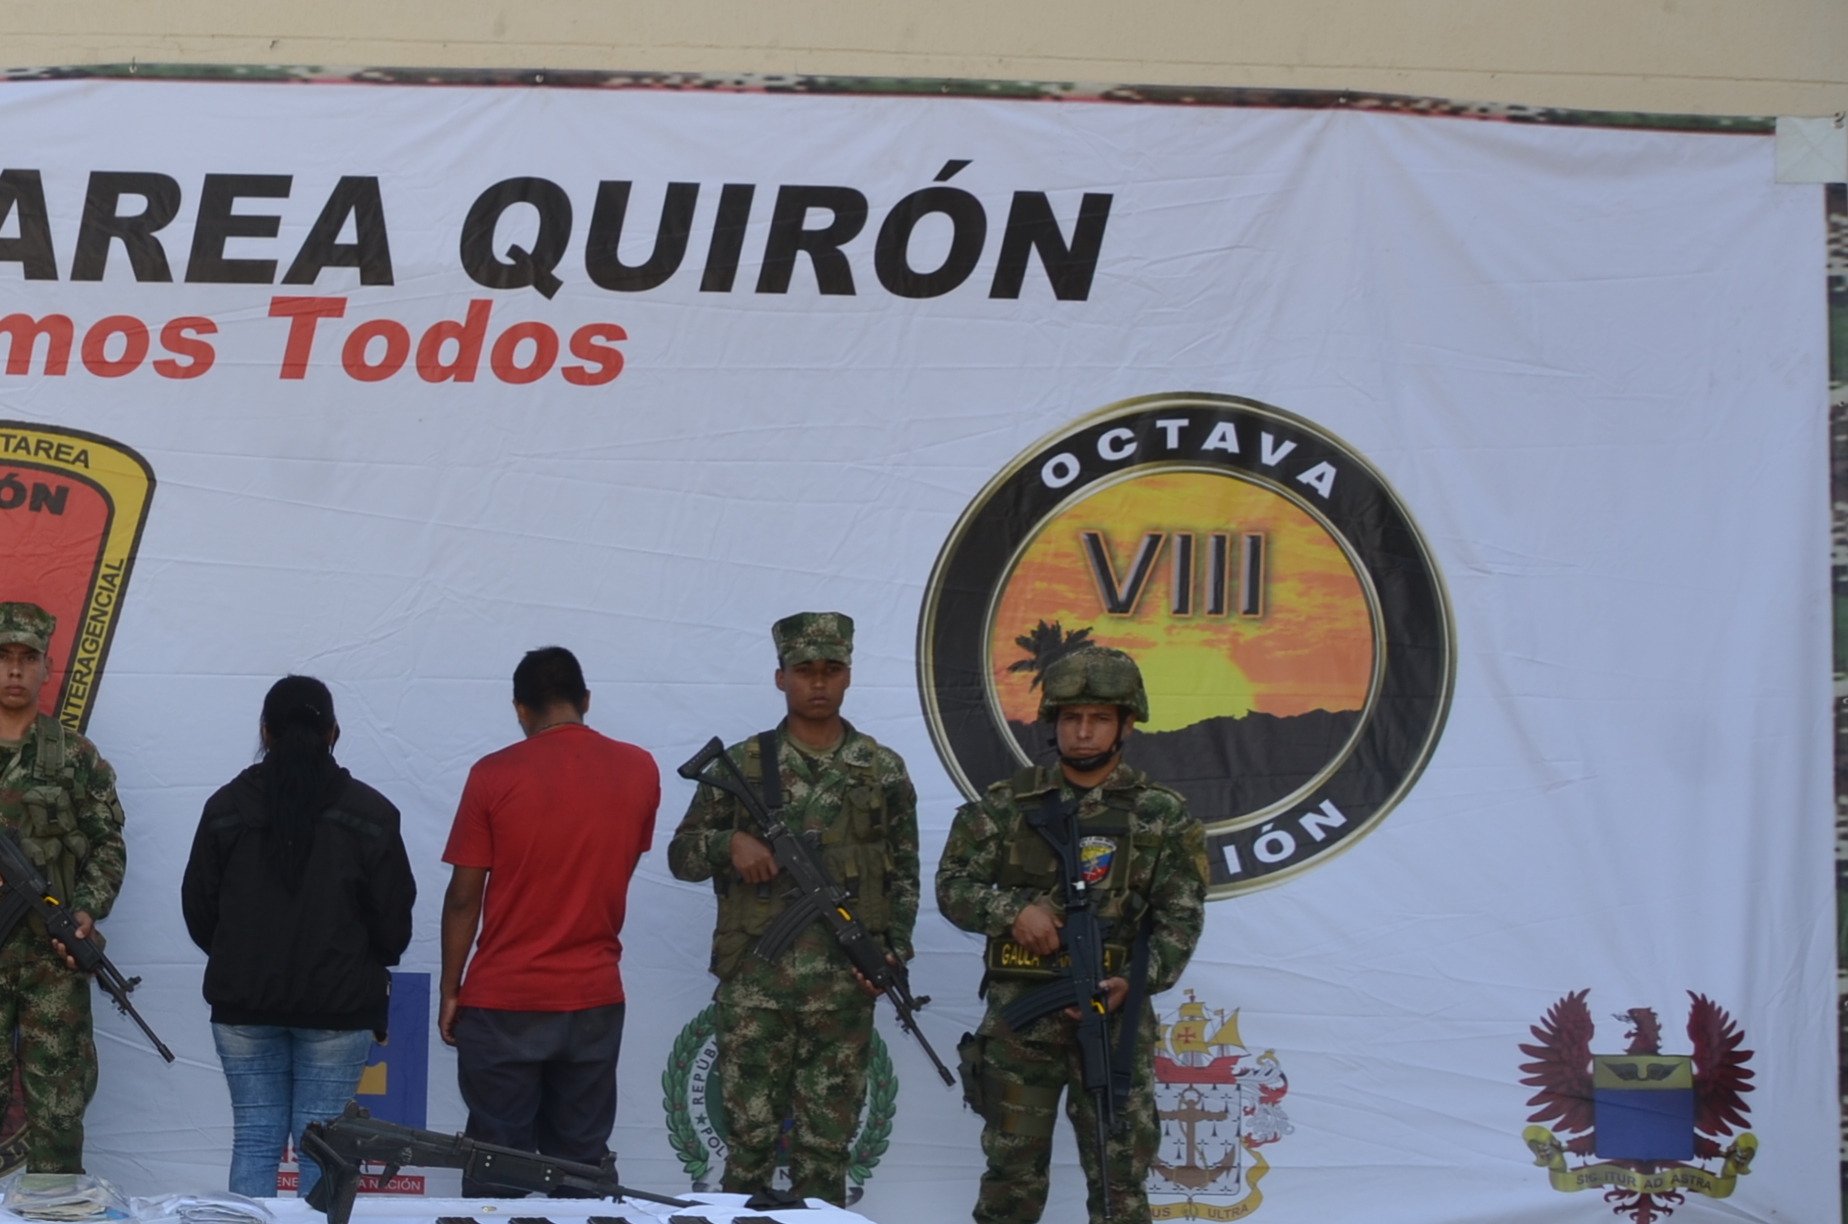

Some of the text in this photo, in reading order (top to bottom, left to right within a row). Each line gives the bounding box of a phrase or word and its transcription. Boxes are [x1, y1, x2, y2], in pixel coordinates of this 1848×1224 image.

[458, 158, 1115, 302] QUIRÓN
[265, 294, 629, 386] Todos
[1040, 417, 1339, 500] OCTAVA
[1079, 530, 1267, 618] VIII
[61, 557, 125, 730] NTERAGENCIAL
[691, 1040, 718, 1106] REPÚB
[369, 1177, 421, 1191] NCIÓN
[1152, 1203, 1250, 1220] US ULTRA
[1644, 1176, 1664, 1189] AD
[1670, 1172, 1712, 1191] ASTRA
